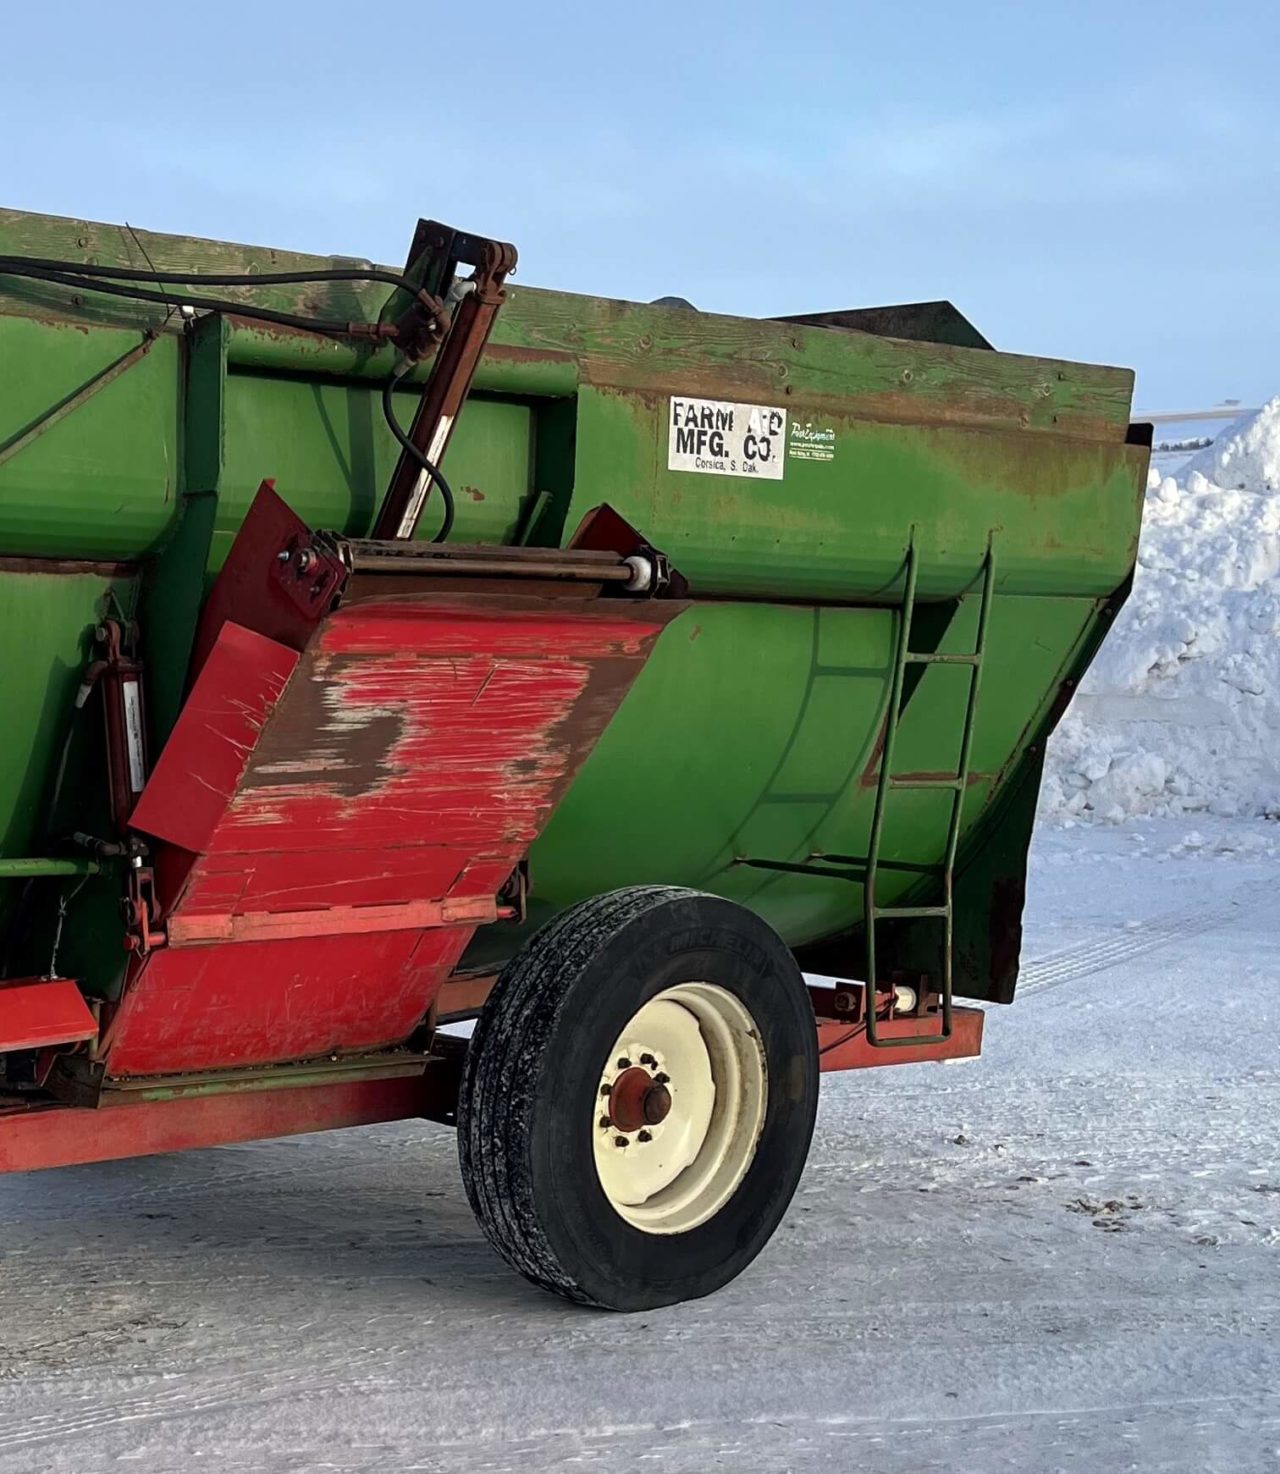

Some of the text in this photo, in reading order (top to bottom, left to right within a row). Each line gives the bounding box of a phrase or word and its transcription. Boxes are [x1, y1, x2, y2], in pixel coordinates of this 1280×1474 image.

[673, 401, 734, 431] FARM
[676, 428, 729, 458] MFG.
[695, 457, 726, 471] Corsica,
[730, 461, 737, 471] S.
[670, 929, 768, 968] MICHELIN
